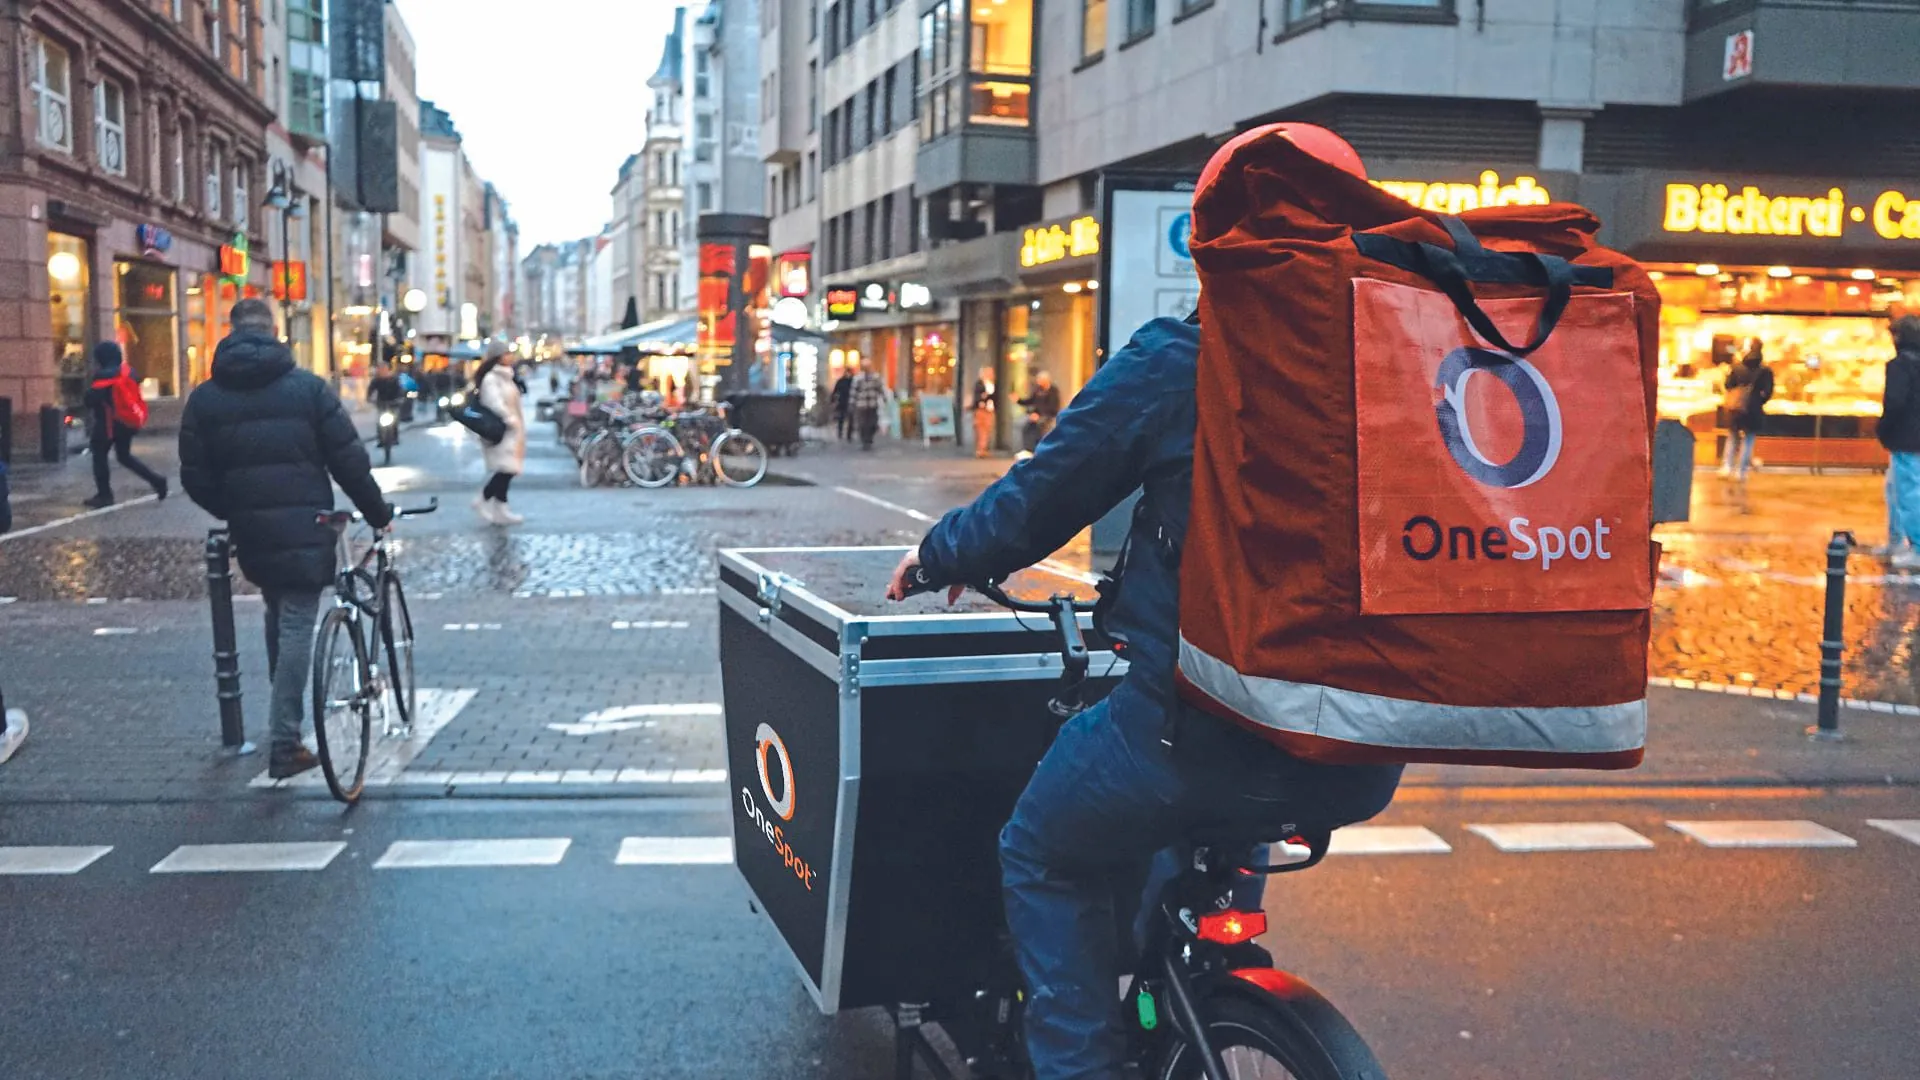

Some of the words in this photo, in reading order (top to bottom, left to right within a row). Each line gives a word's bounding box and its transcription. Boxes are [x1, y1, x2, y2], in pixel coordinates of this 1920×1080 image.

[1663, 183, 1845, 237] Bäckerei
[1402, 514, 1612, 571] OneSpot
[741, 786, 813, 891] OneSpot
